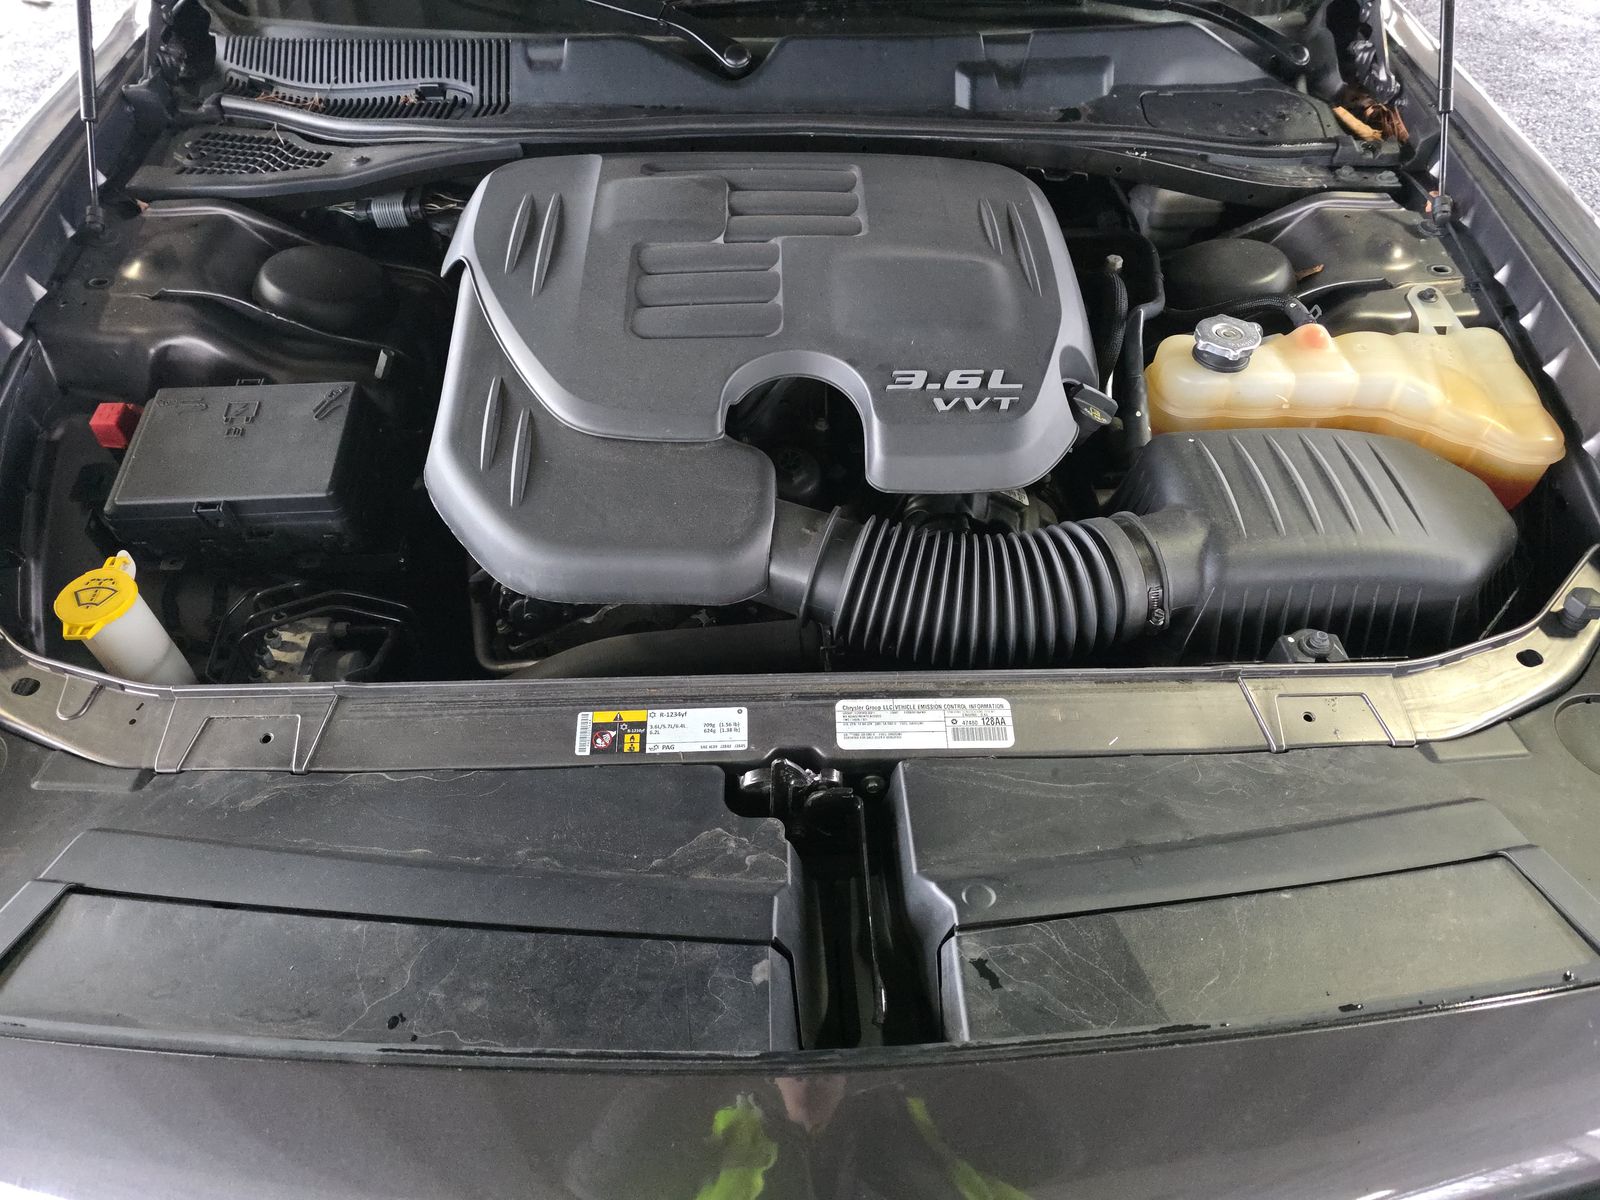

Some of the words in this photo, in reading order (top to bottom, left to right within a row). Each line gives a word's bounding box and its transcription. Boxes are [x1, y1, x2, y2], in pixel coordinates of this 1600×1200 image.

[886, 369, 1023, 392] 3.6L
[933, 397, 1020, 413] VVT
[981, 716, 1007, 726] 128AA
